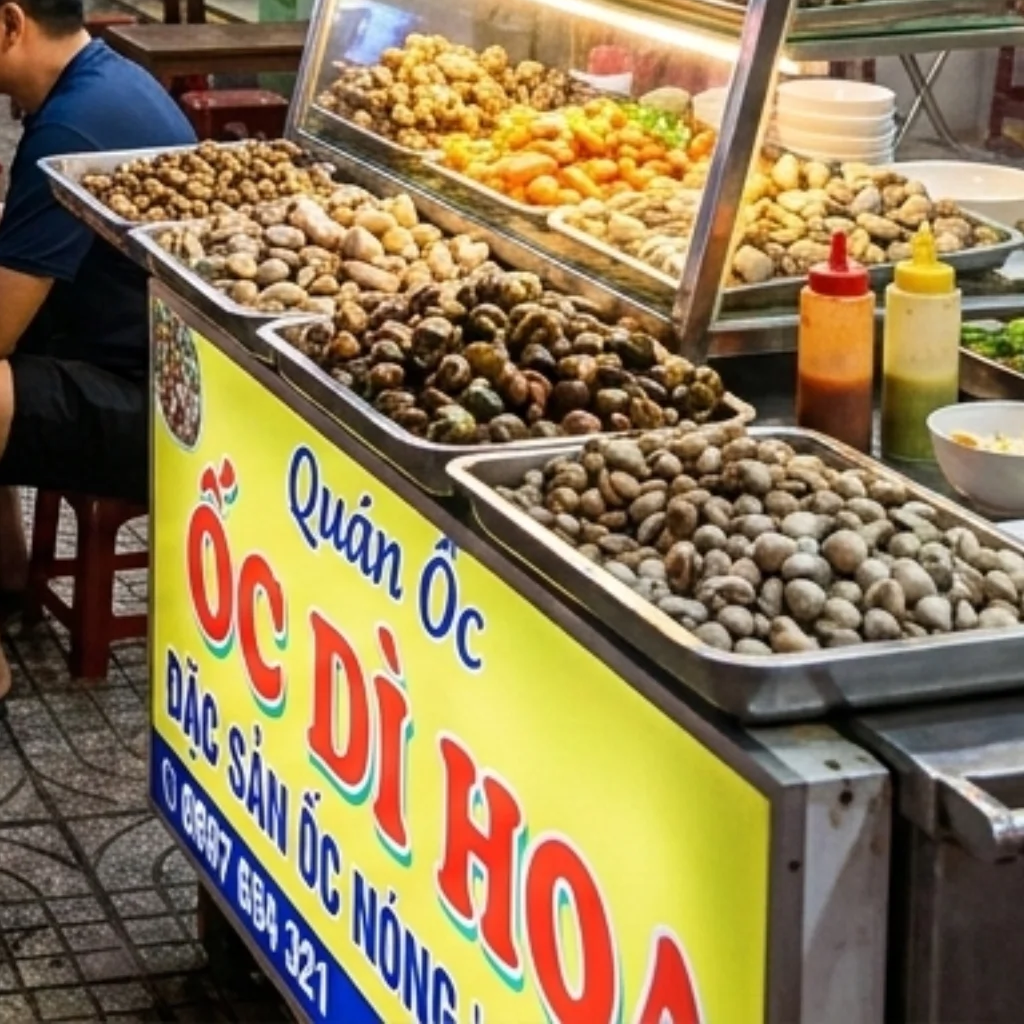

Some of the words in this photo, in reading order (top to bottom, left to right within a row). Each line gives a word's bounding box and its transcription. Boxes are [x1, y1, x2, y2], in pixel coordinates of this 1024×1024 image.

[289, 447, 403, 601] Quán
[187, 458, 287, 714] ỐC
[308, 608, 413, 860] DÌ
[167, 649, 219, 766] ĐẶC
[298, 791, 341, 916] ỐC
[285, 920, 327, 1018] 321
